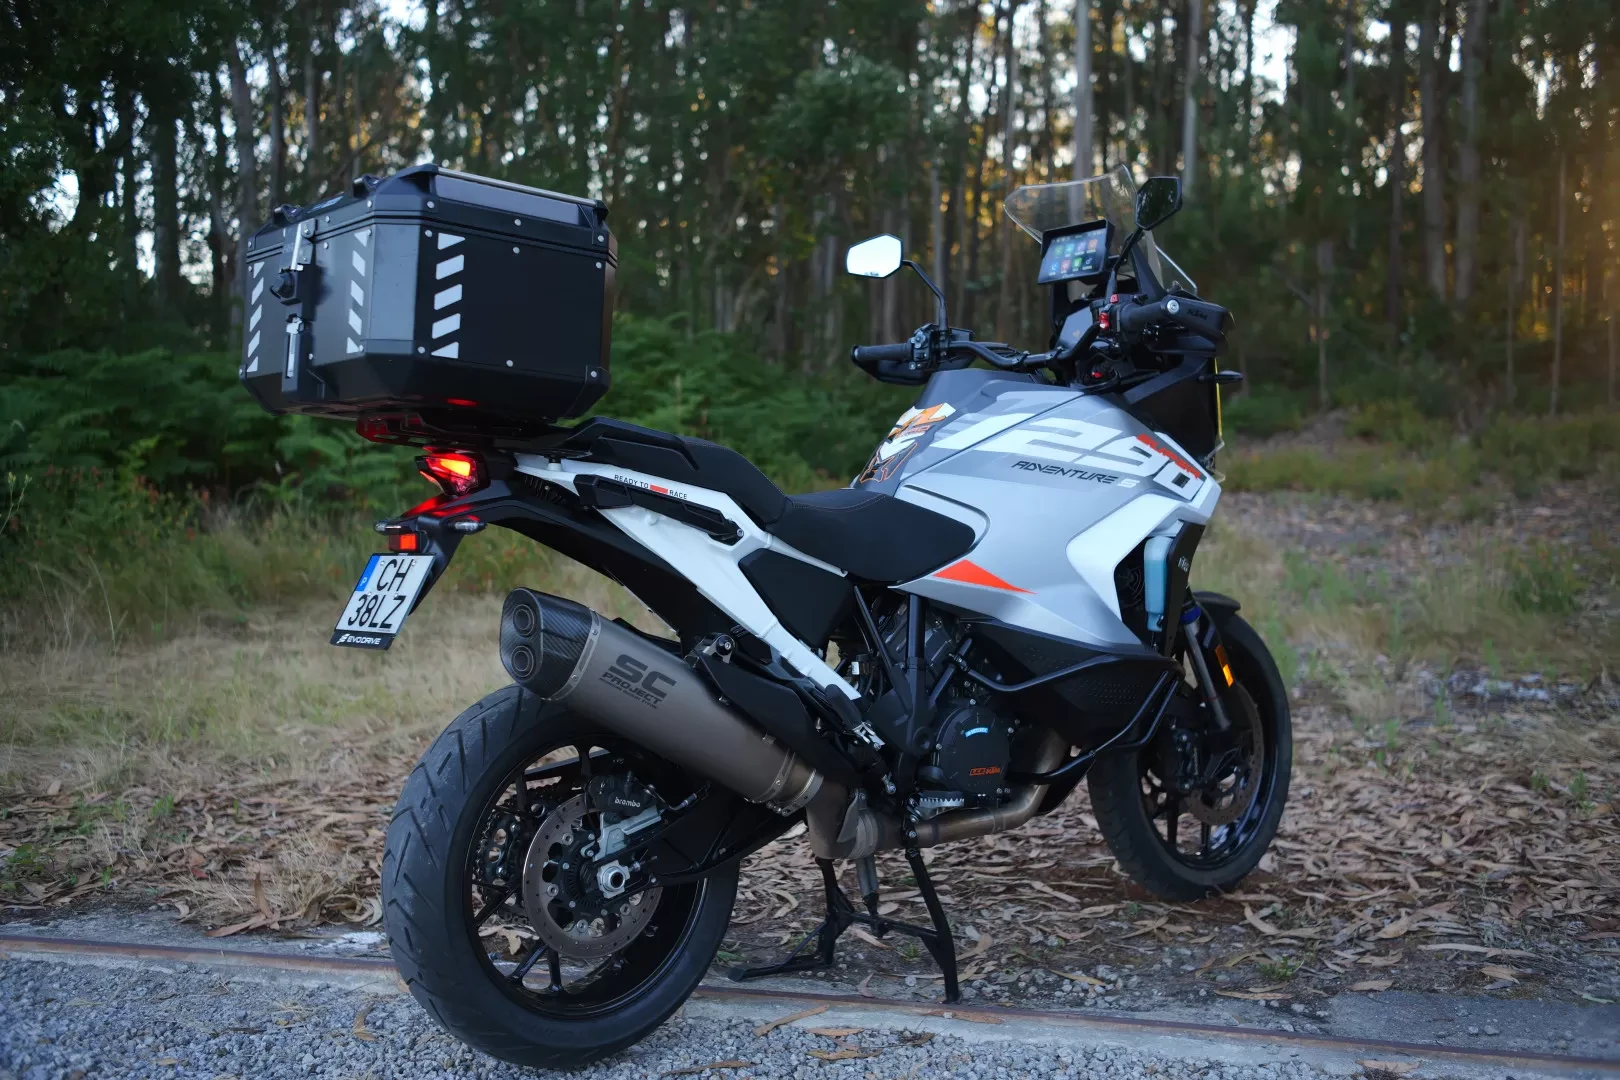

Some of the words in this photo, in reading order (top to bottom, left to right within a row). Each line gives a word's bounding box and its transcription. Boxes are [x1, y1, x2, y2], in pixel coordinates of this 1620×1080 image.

[1011, 460, 1119, 485] ADVENTURE
[1136, 433, 1202, 480] SUPER
[614, 474, 638, 487] READY
[640, 481, 649, 489] TO
[669, 489, 688, 500] RACE
[376, 558, 414, 592] CH
[348, 594, 406, 628] 38LZ
[347, 636, 381, 645] EVODRIVE
[601, 672, 662, 705] PROJECT
[608, 654, 677, 700] SC
[614, 796, 640, 808] brembo
